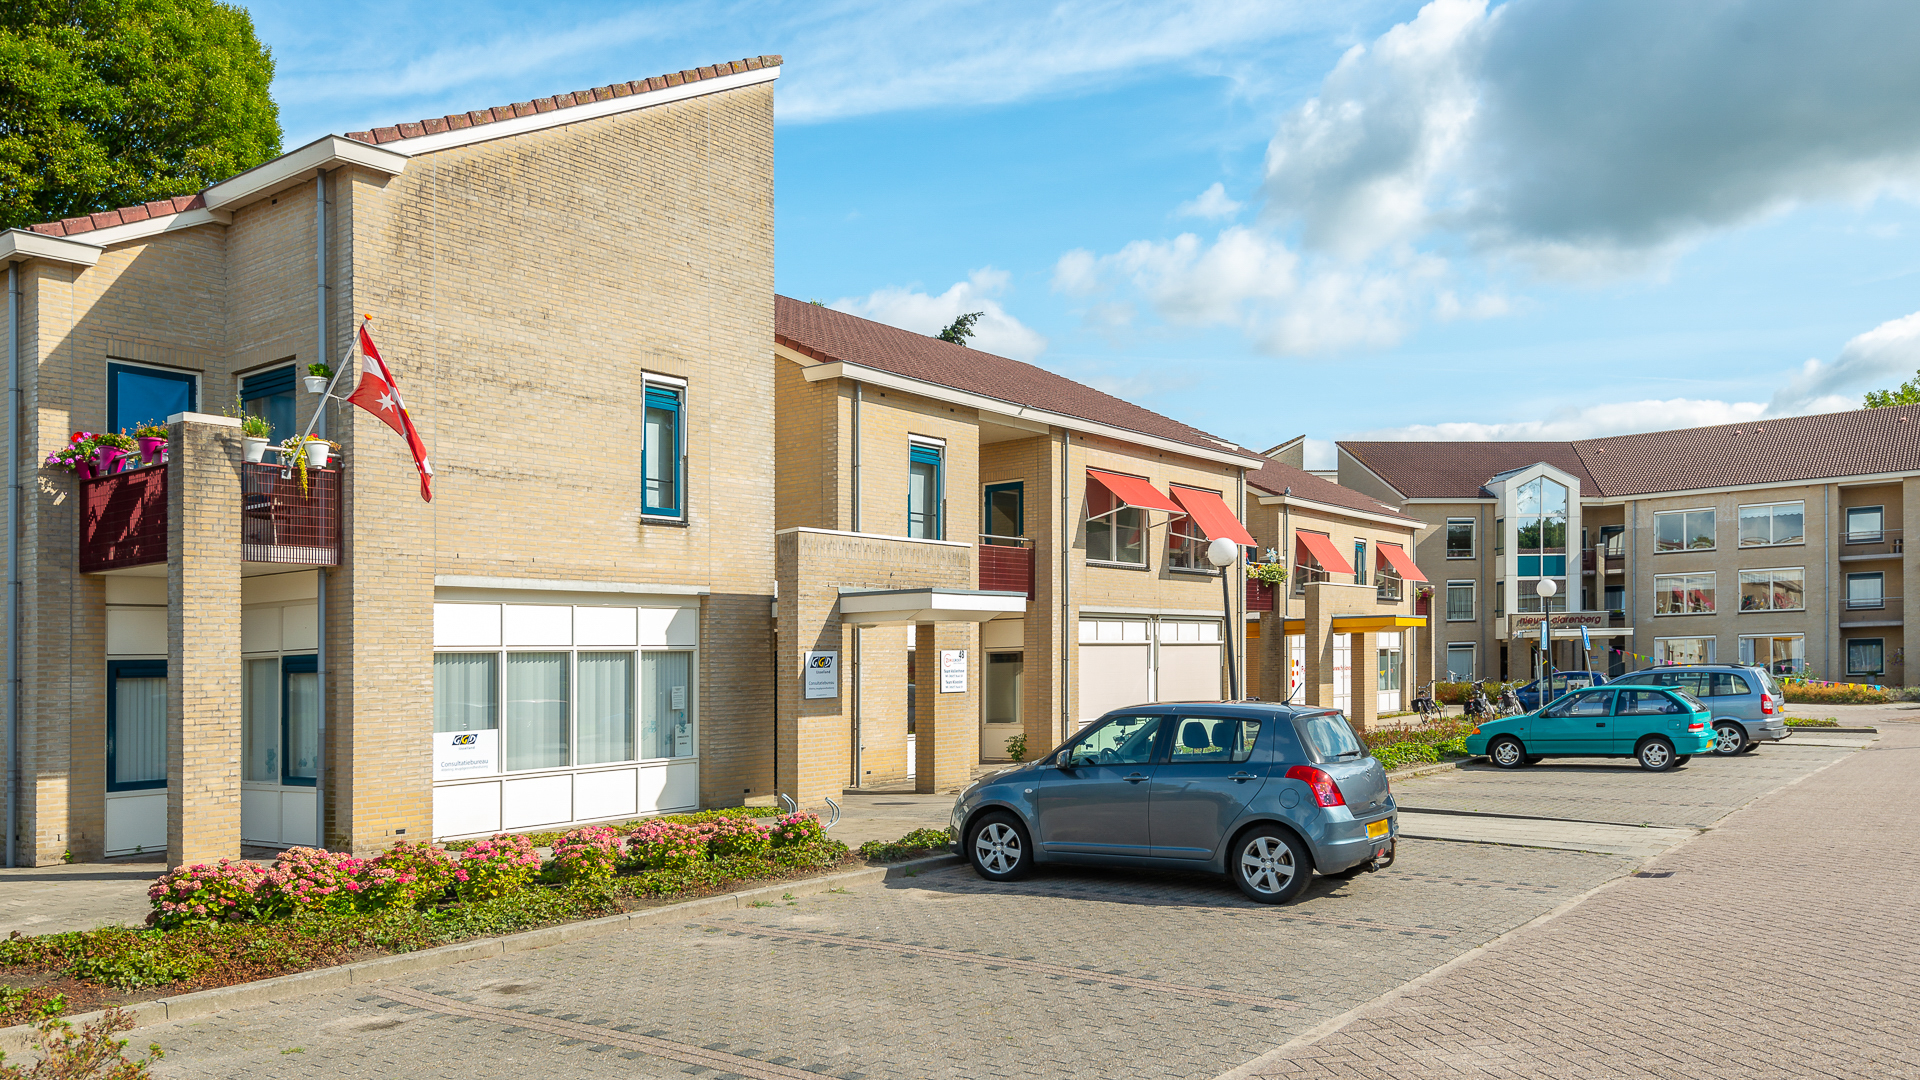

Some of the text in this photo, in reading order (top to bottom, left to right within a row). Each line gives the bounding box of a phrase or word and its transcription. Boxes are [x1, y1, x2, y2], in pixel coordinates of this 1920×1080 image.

[1552, 615, 1601, 624] clarenberg
[810, 656, 833, 668] GGD
[452, 734, 478, 745] GGD
